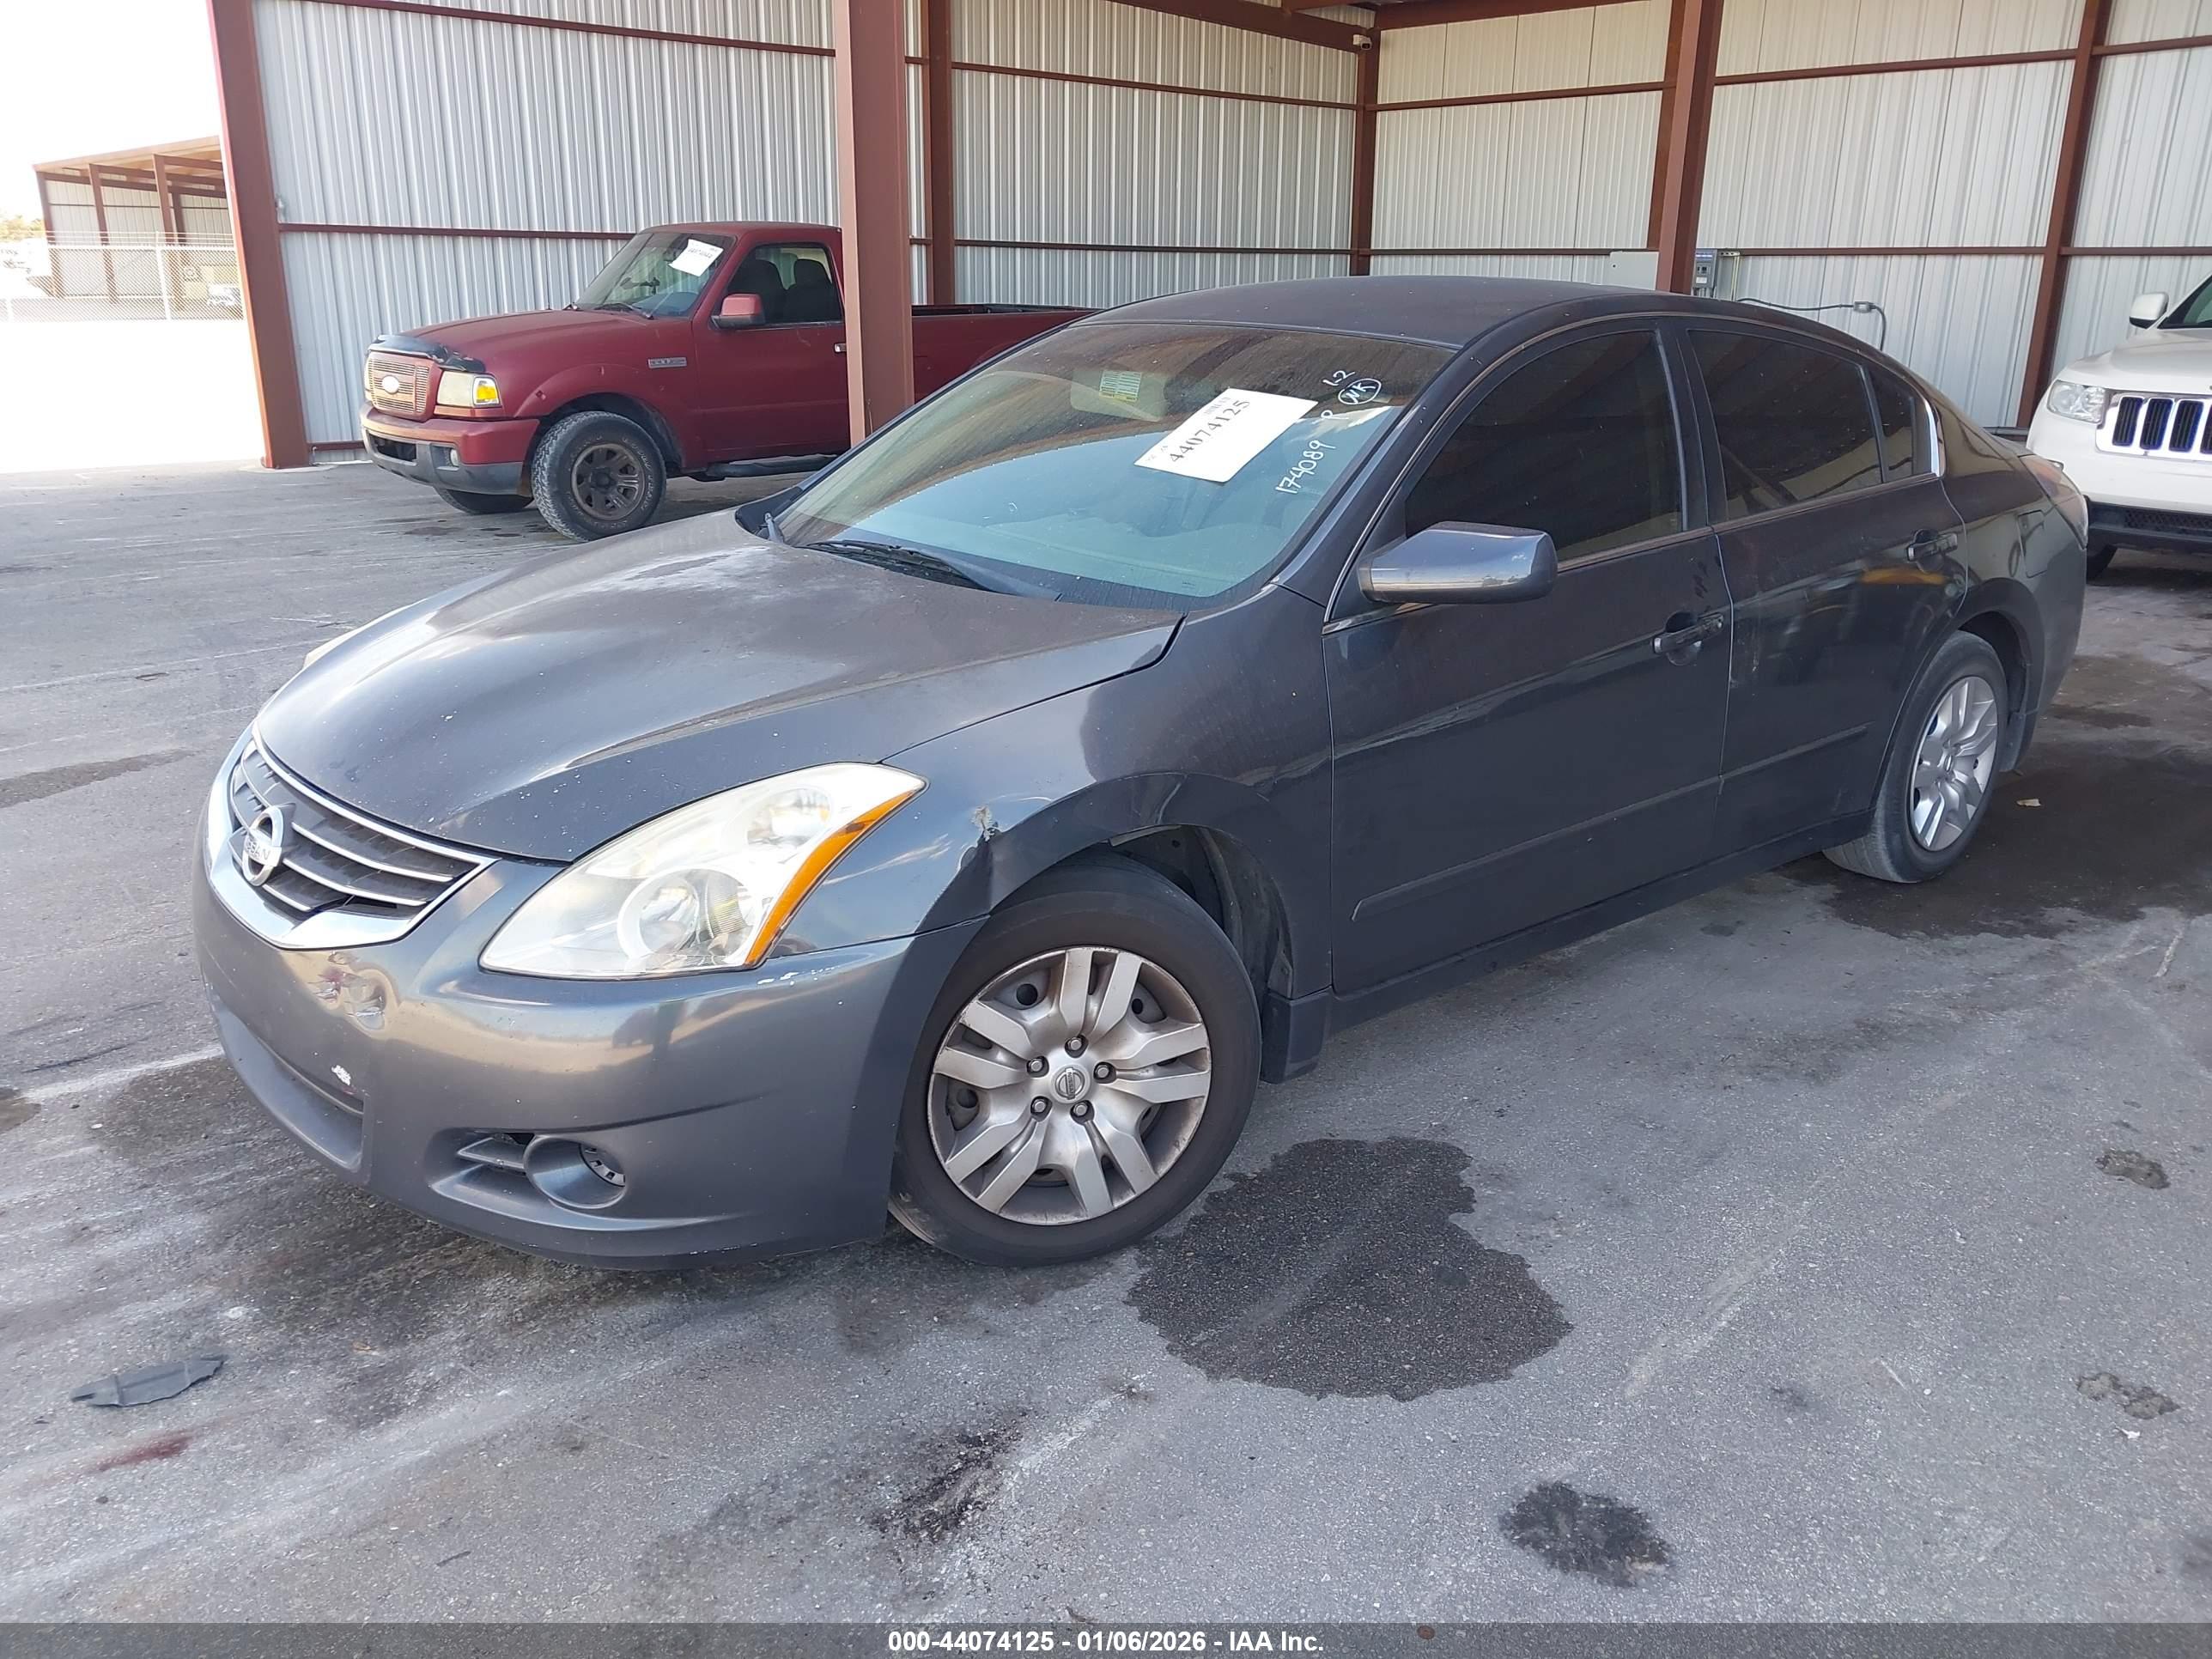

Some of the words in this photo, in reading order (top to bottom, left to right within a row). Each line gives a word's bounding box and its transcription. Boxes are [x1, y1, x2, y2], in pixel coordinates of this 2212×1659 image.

[1322, 370, 1356, 386] 1-2
[1170, 399, 1250, 462] 44074125
[1275, 440, 1336, 495] 174089
